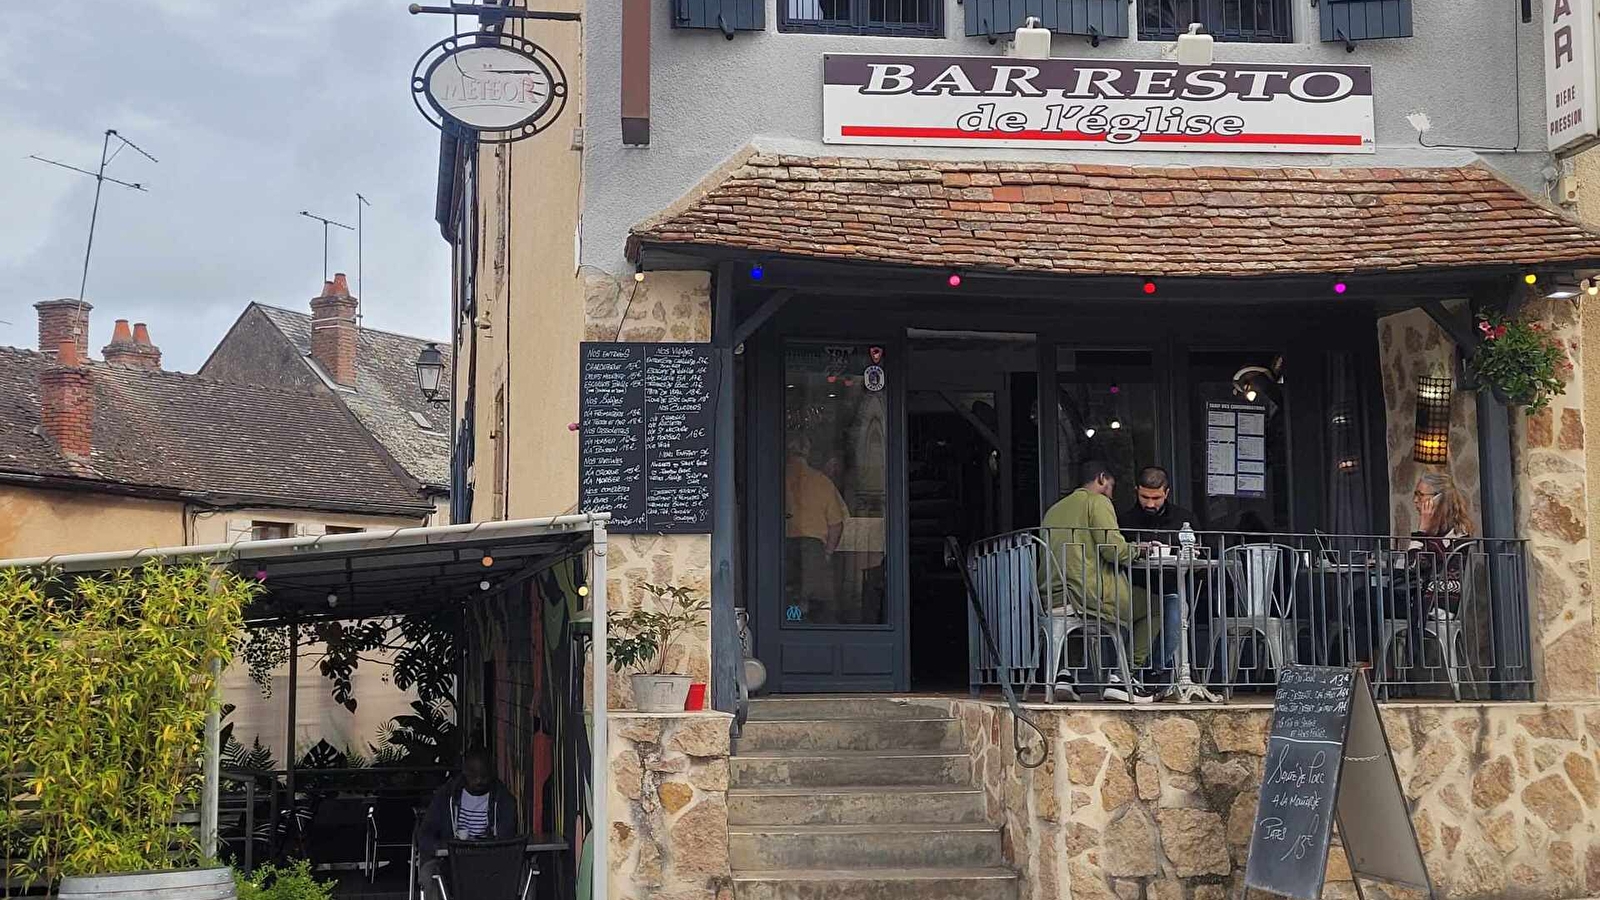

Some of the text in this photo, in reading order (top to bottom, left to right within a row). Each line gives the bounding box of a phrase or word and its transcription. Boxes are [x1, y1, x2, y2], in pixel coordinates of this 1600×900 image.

[860, 63, 1354, 103] BAR RESTO
[1555, 85, 1575, 108] BIERE
[957, 103, 1245, 144] de l'église
[1550, 108, 1582, 136] PRESSION
[587, 349, 600, 358] NOS
[584, 397, 598, 405] NOS
[584, 457, 597, 466] NOS
